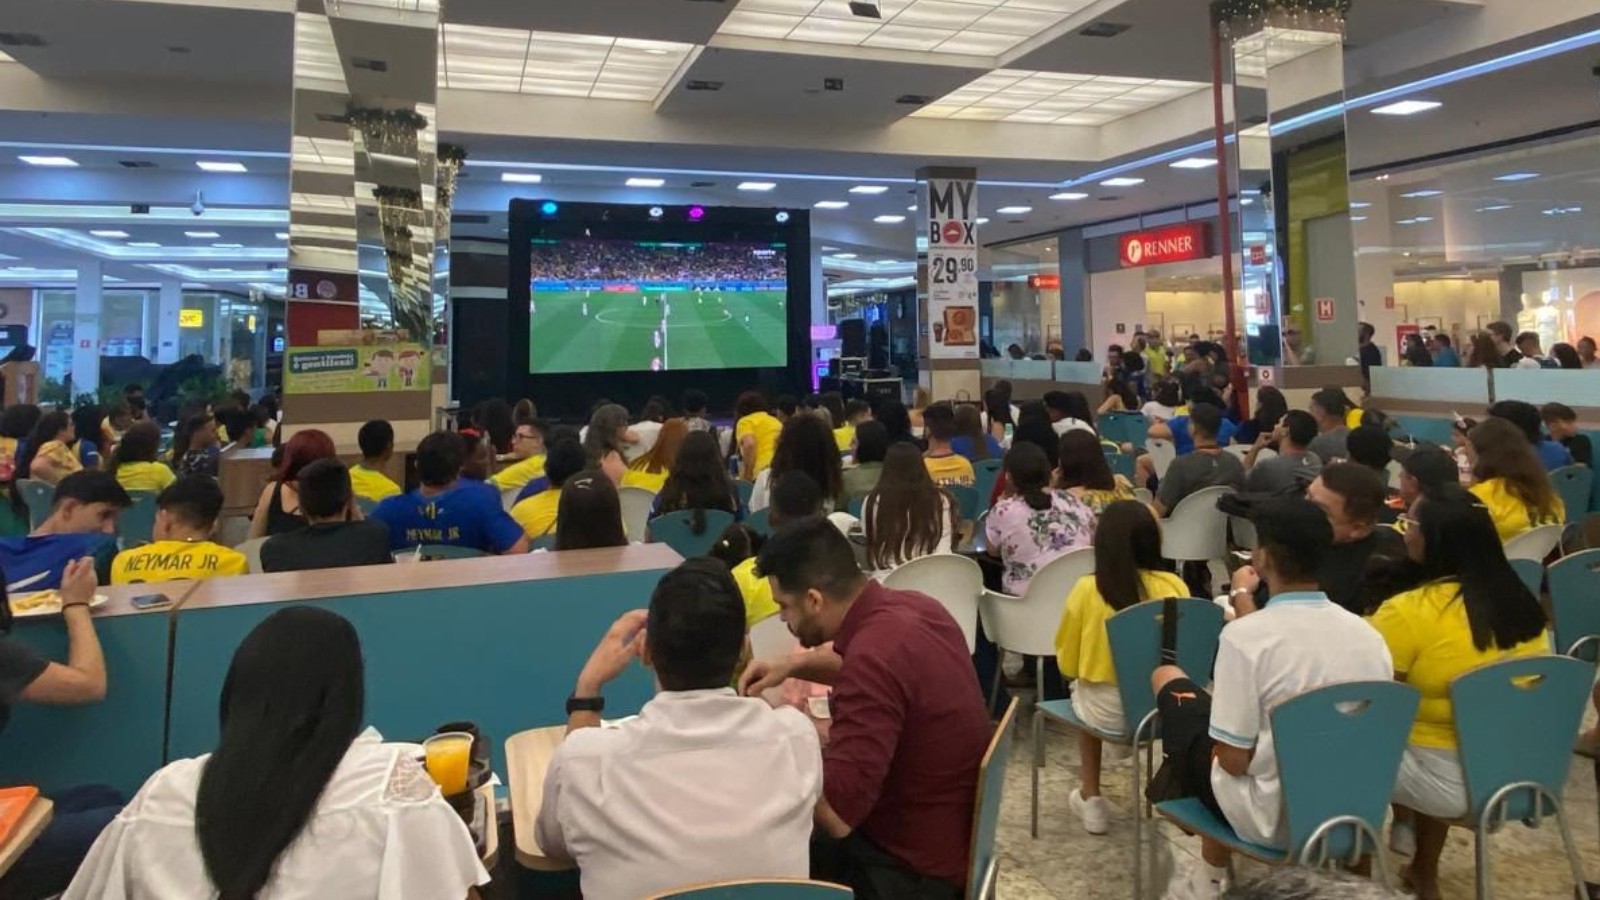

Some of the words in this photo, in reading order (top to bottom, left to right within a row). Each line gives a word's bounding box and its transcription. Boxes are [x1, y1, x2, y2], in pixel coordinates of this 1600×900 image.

[929, 181, 974, 219] MY
[1144, 235, 1193, 257] RENNER
[1320, 301, 1331, 315] H
[124, 554, 192, 573] NEYMAR
[197, 554, 219, 571] JR
